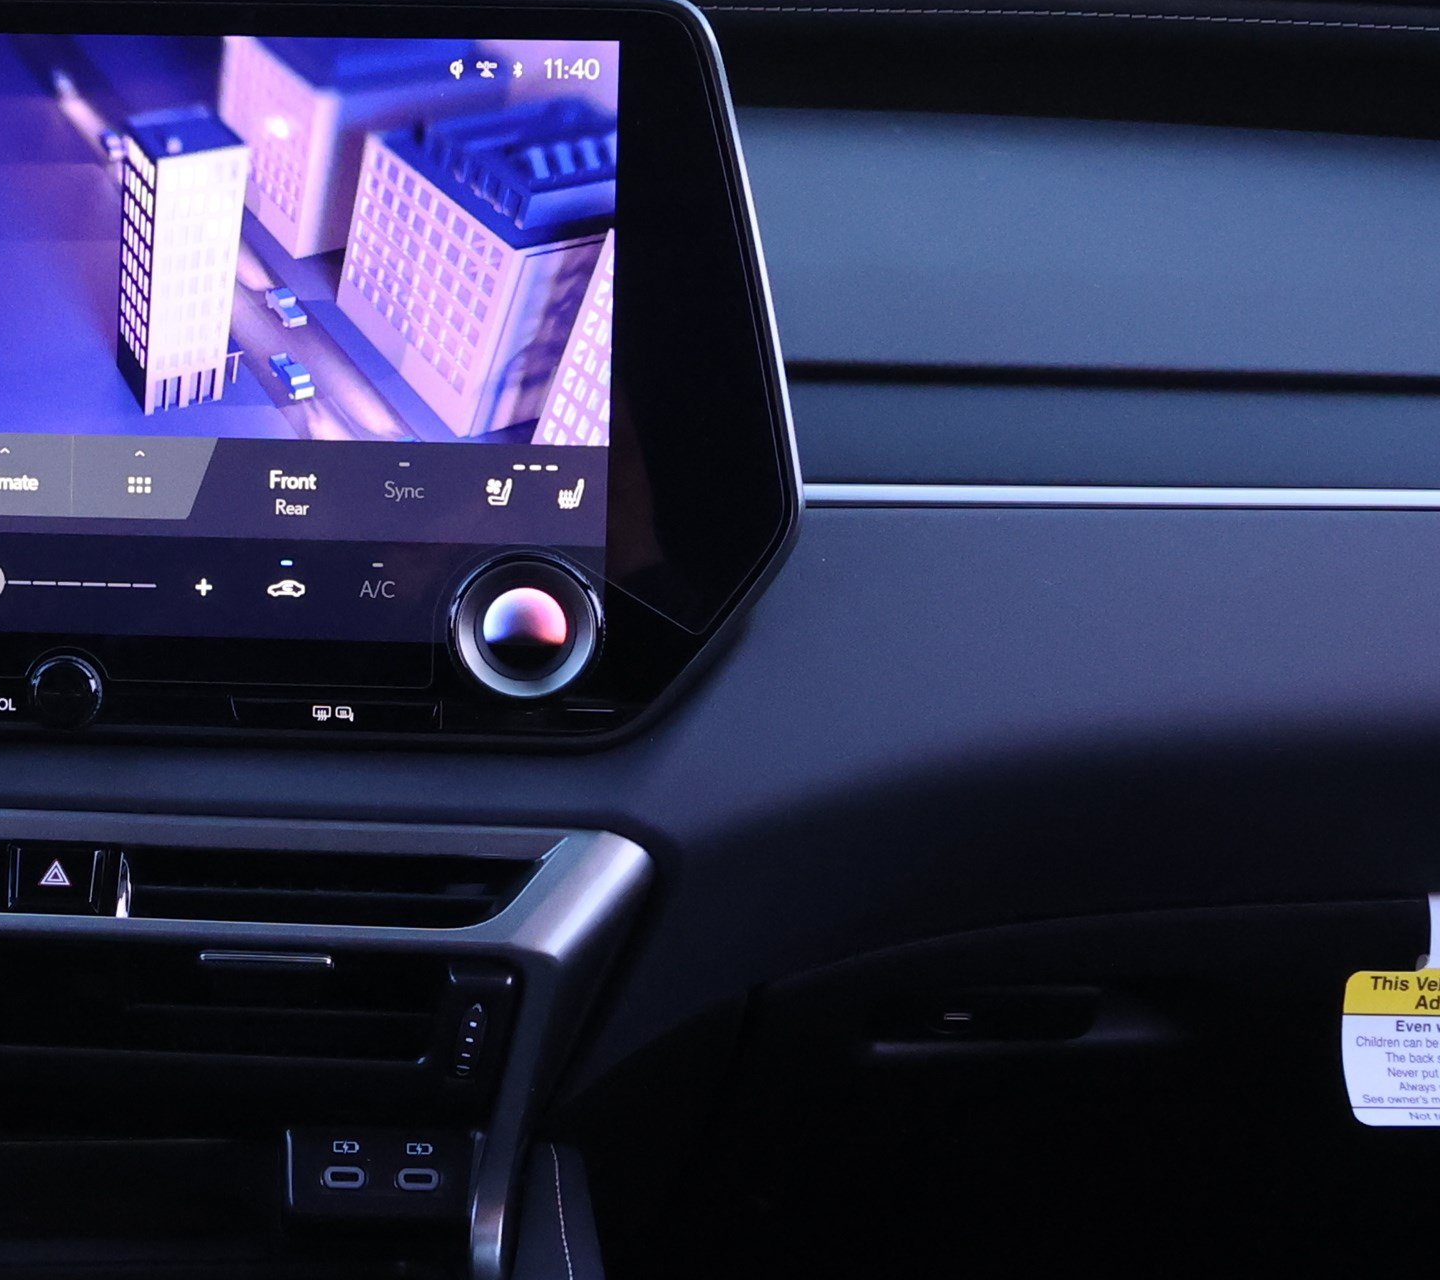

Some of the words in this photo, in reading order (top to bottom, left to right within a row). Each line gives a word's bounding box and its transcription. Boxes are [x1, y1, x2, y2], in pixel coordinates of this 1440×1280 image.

[543, 58, 601, 81] 11:40
[269, 470, 317, 491] Front
[384, 481, 425, 502] Sync
[275, 499, 310, 516] Rear
[360, 579, 396, 601] A/C
[1370, 976, 1410, 991] This
[1395, 1020, 1432, 1032] Even
[1355, 1035, 1400, 1048] Children
[1403, 1038, 1421, 1048] can
[1425, 1036, 1439, 1048] be
[1385, 1052, 1406, 1063] The
[1409, 1053, 1434, 1064] back
[1387, 1067, 1418, 1078] Never
[1421, 1069, 1440, 1080] put
[1399, 1081, 1436, 1094] Always
[1362, 1094, 1384, 1104] See
[1387, 1094, 1429, 1105] owner's
[1409, 1111, 1432, 1121] Not
